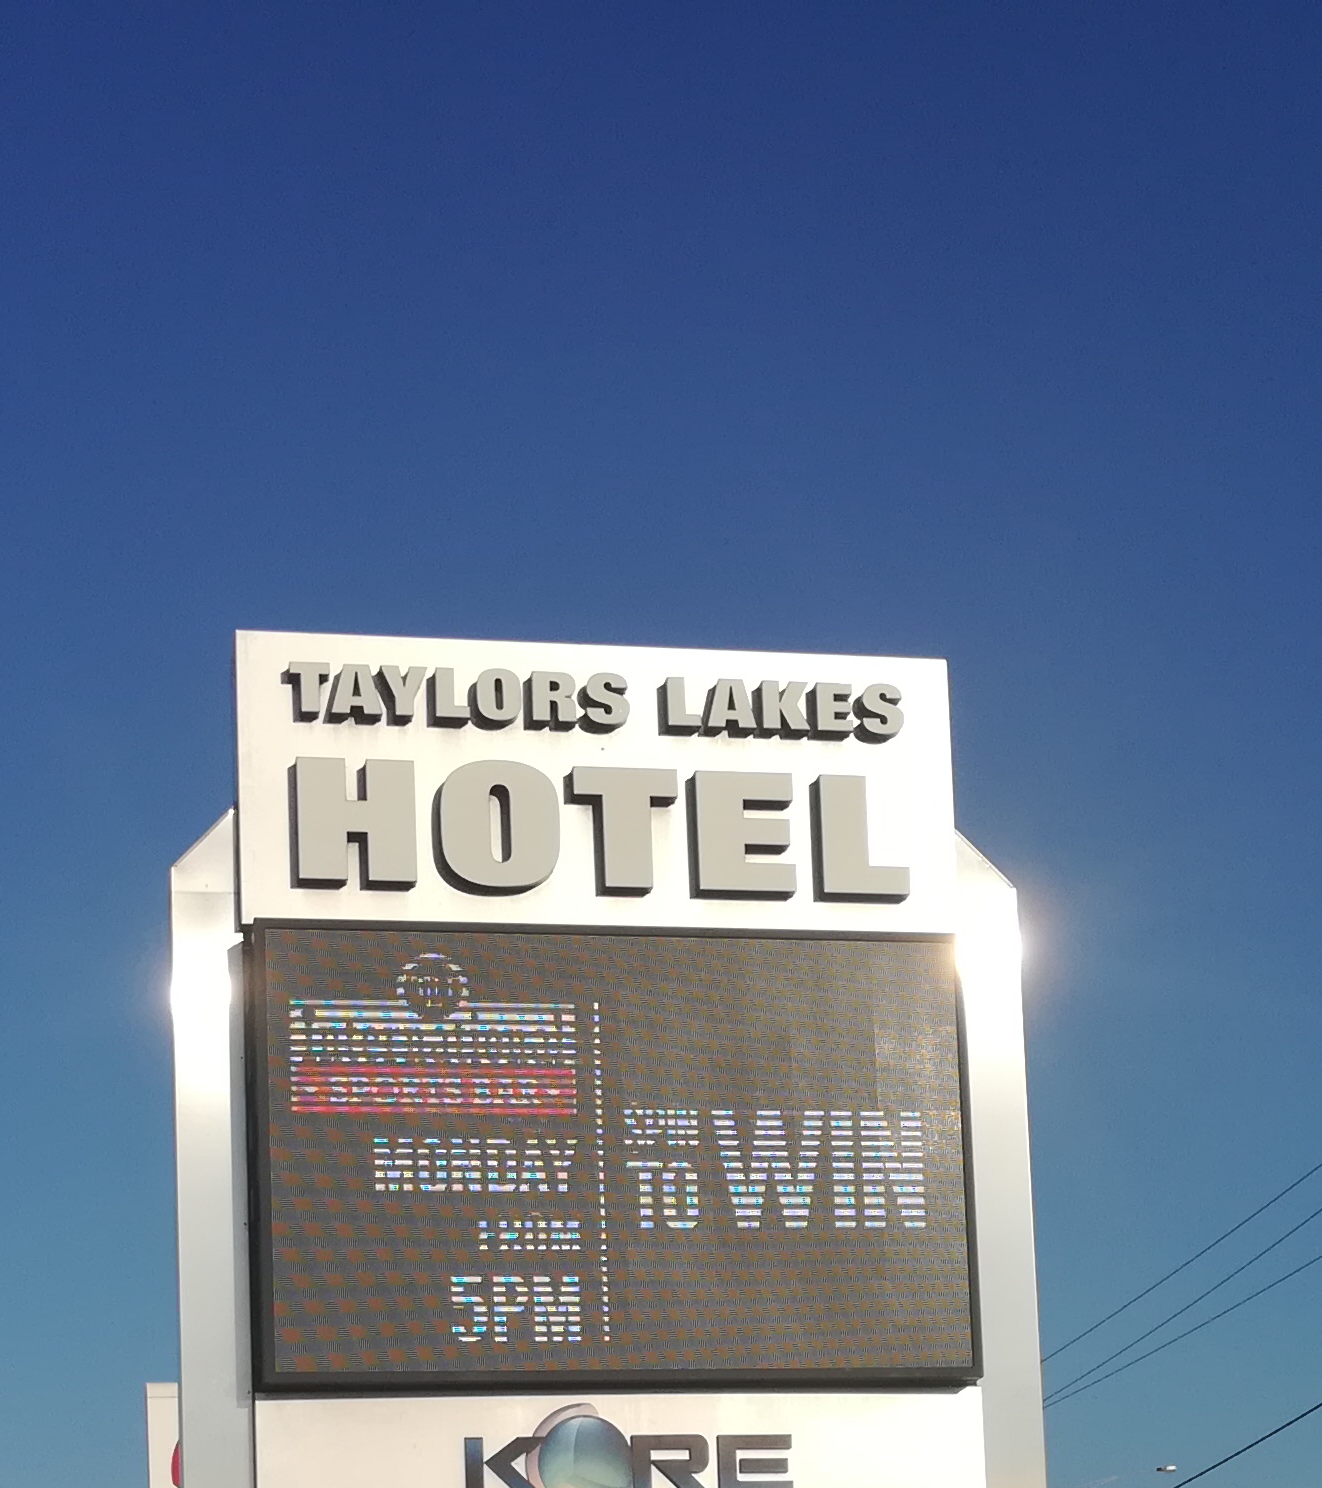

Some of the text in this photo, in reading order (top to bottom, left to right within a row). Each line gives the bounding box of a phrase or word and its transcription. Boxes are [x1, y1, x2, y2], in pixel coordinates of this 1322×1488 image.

[282, 660, 905, 744] TAYLORS LAKES
[289, 755, 911, 904] HOTEL
[374, 1137, 579, 1192] MONDAY
[626, 1109, 928, 1230] TO WIN
[450, 1275, 583, 1343] 5PM
